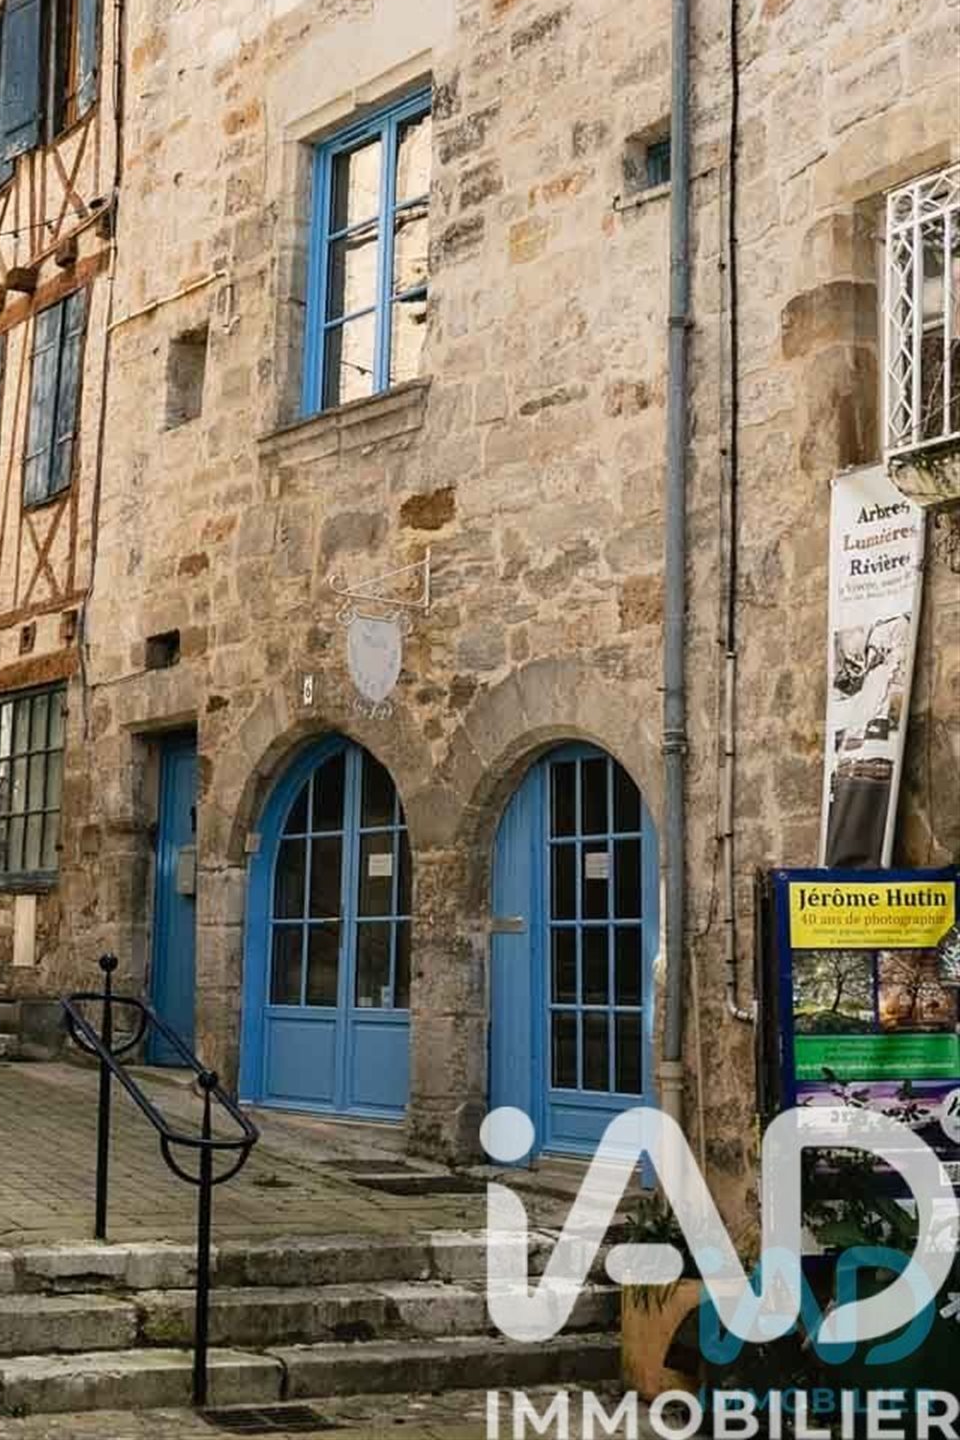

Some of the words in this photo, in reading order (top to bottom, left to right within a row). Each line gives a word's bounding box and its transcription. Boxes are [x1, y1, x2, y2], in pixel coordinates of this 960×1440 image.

[800, 888, 879, 910] Jérôme
[887, 888, 947, 906] Hutin
[802, 913, 816, 925] 40
[820, 914, 842, 925] ans
[845, 911, 860, 925] de
[864, 912, 946, 927] photographie
